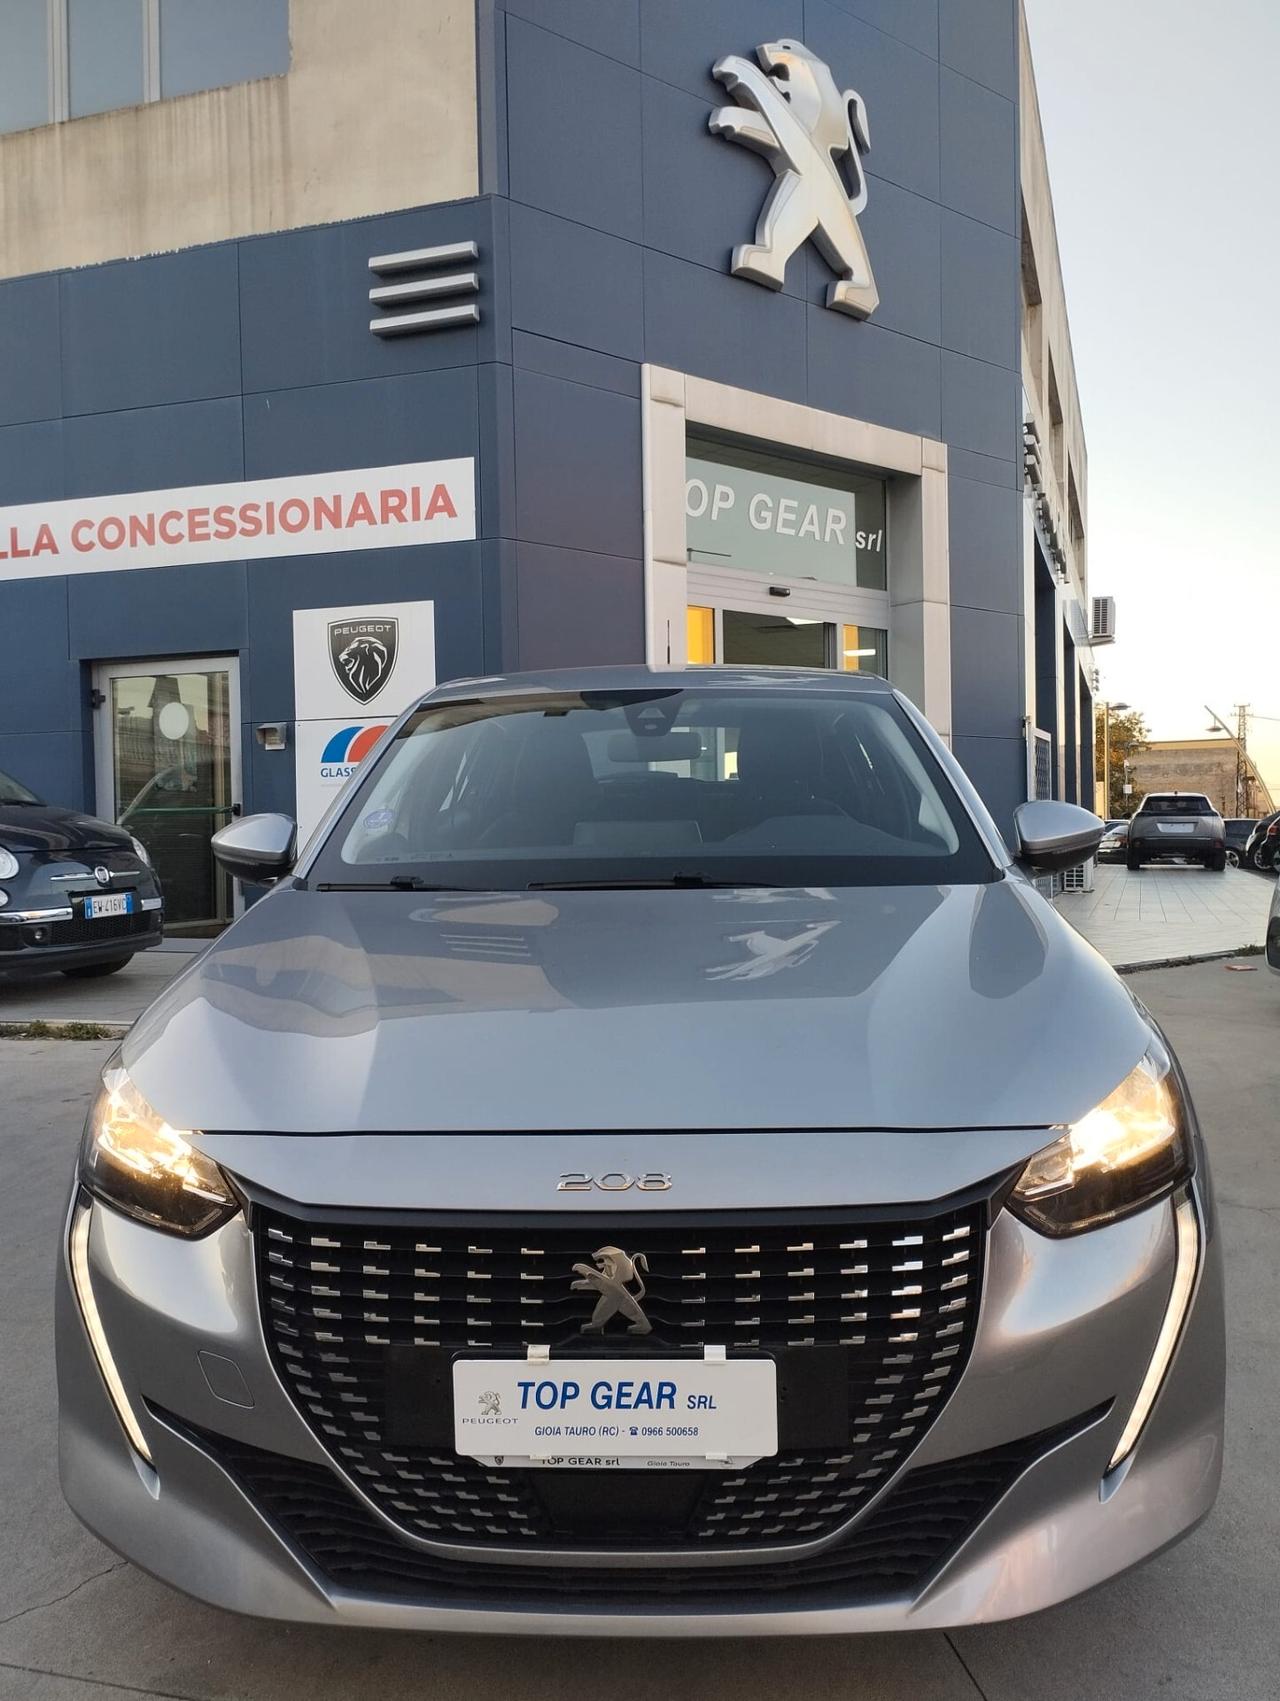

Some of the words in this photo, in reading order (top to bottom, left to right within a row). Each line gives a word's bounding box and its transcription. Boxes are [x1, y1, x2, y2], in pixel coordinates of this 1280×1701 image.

[0, 523, 60, 559] LA
[71, 483, 458, 553] CONCESSIONARIA
[749, 492, 847, 545] GEAR
[855, 529, 883, 552] srl
[334, 625, 392, 636] PEUGEOT
[556, 1172, 673, 1191] 208
[517, 1381, 580, 1410] TOP
[590, 1381, 677, 1410] GEAR
[687, 1395, 718, 1410] SRL
[462, 1417, 519, 1425] PEUGEOT
[534, 1426, 562, 1436] GIOIA
[564, 1426, 597, 1436] TAURO
[598, 1426, 620, 1437] (RC)
[641, 1426, 663, 1436] 0966
[666, 1426, 699, 1436] 500658
[568, 1457, 602, 1466] GEAR
[605, 1457, 621, 1466] srl
